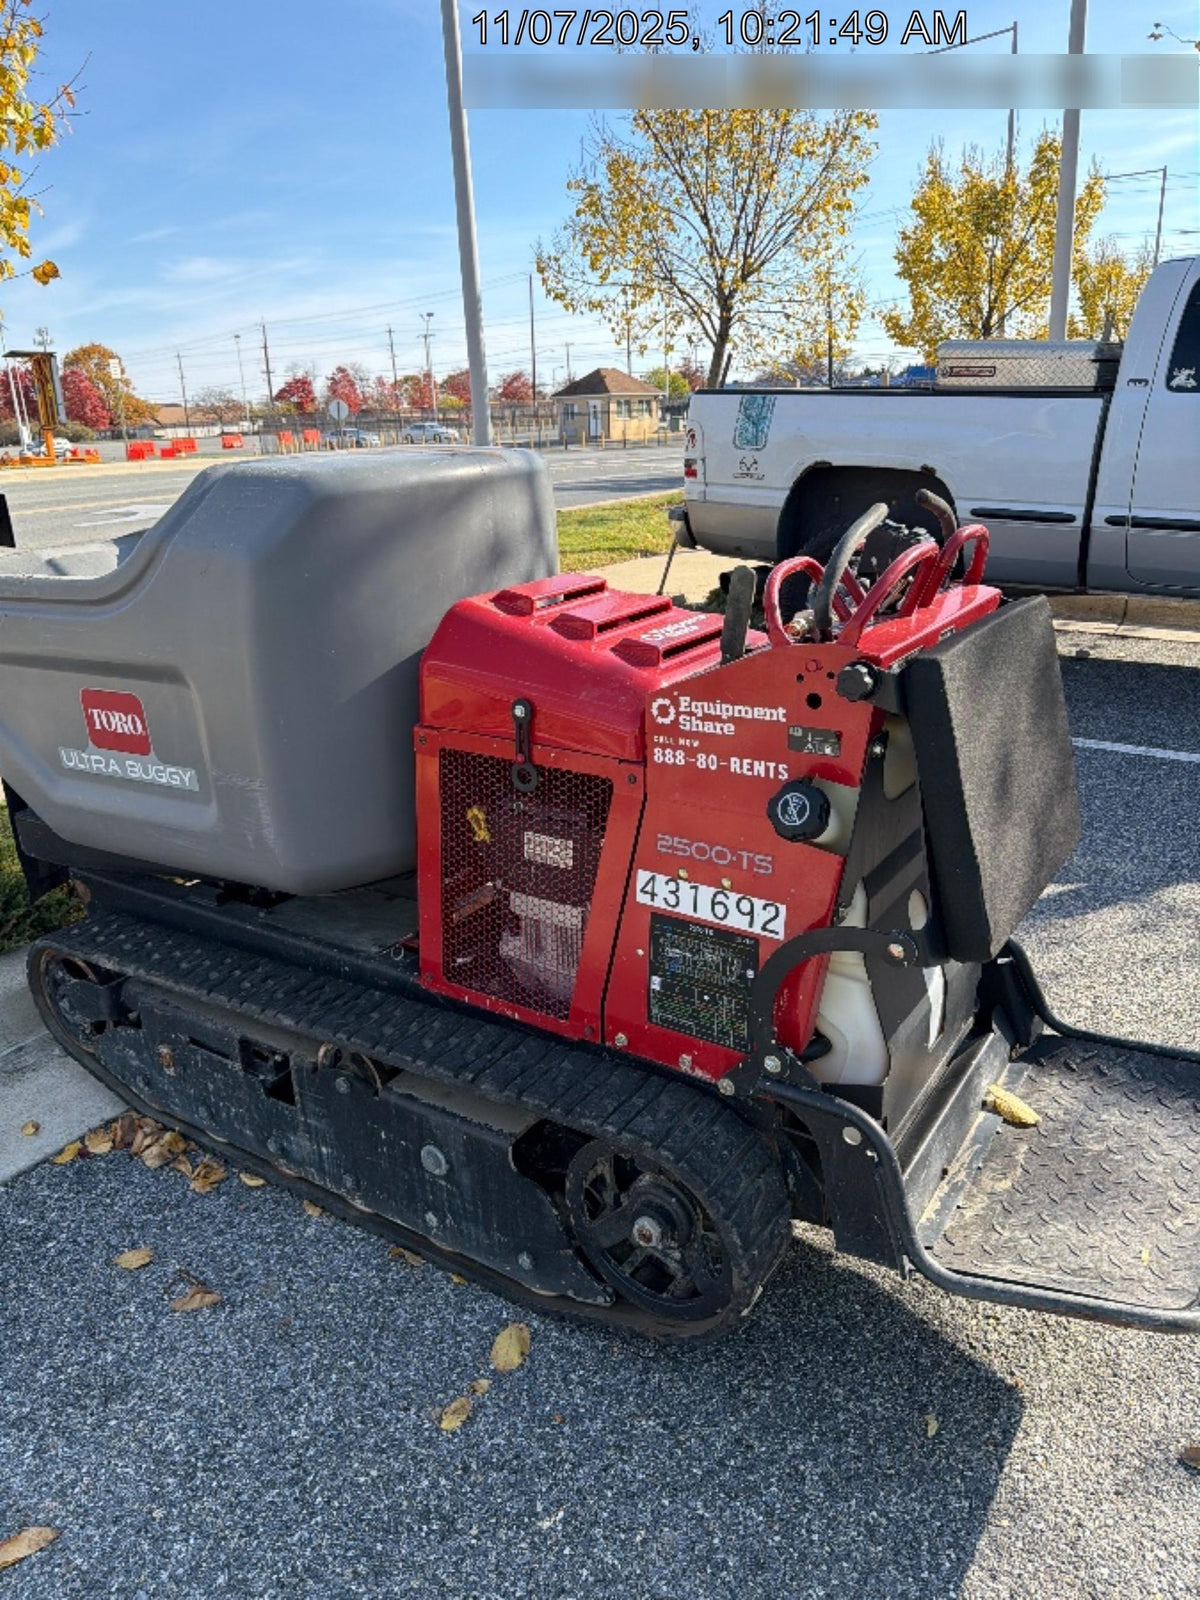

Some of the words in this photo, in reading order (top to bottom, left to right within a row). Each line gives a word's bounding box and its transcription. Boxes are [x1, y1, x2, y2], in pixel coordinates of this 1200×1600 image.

[88, 708, 143, 736] TORO
[678, 695, 787, 723] Equipment
[678, 714, 736, 736] Share
[653, 735, 675, 746] CALL
[678, 736, 700, 748] NOW
[61, 749, 122, 776] ULTRA
[125, 760, 195, 787] BUGGY
[653, 746, 790, 781] 888-80-RENTS
[639, 874, 780, 936] 431692
